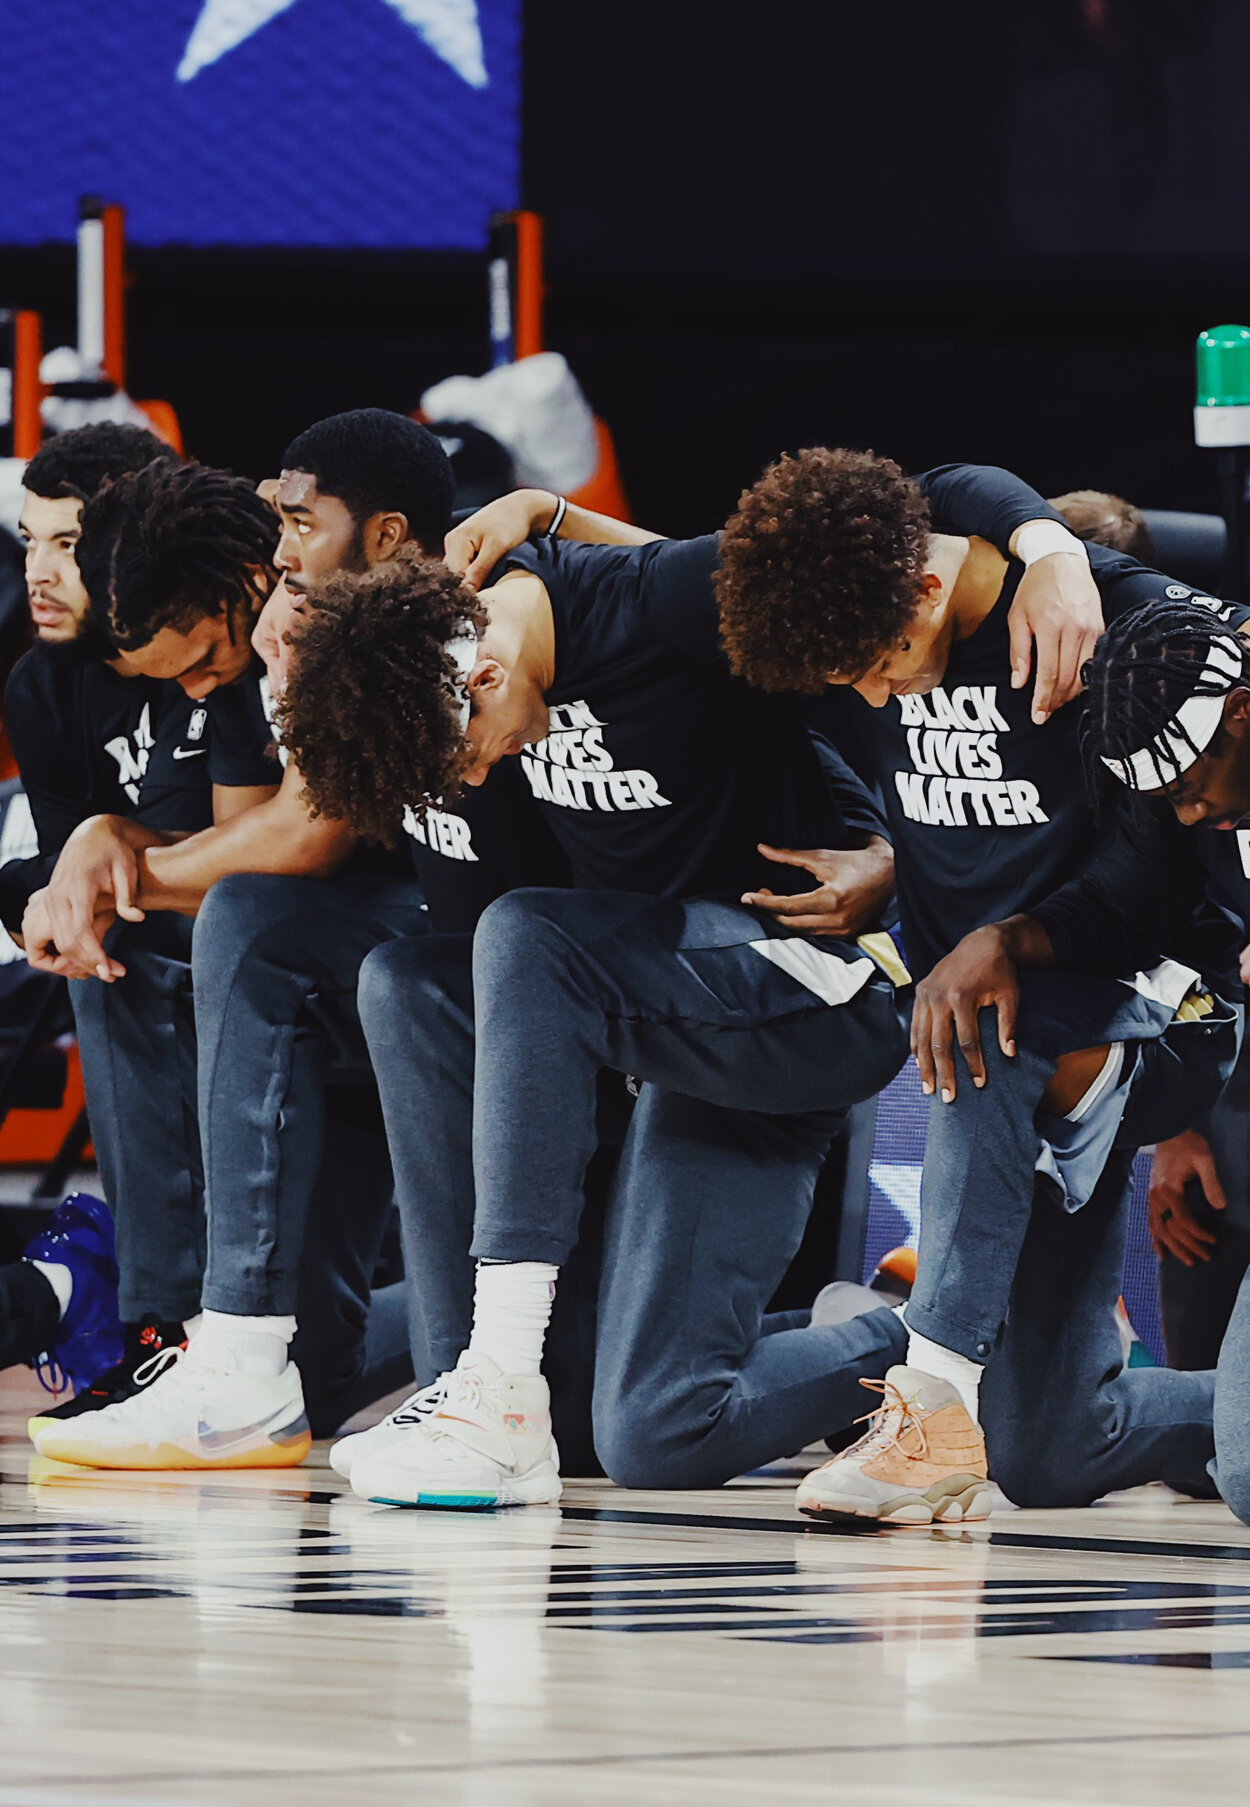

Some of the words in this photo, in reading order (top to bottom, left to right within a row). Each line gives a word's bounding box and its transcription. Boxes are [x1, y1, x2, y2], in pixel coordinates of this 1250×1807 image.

[896, 686, 1010, 731] BLACK
[906, 728, 1003, 779] LIVES
[521, 755, 672, 811] MATTER
[895, 771, 1050, 826] MATTER
